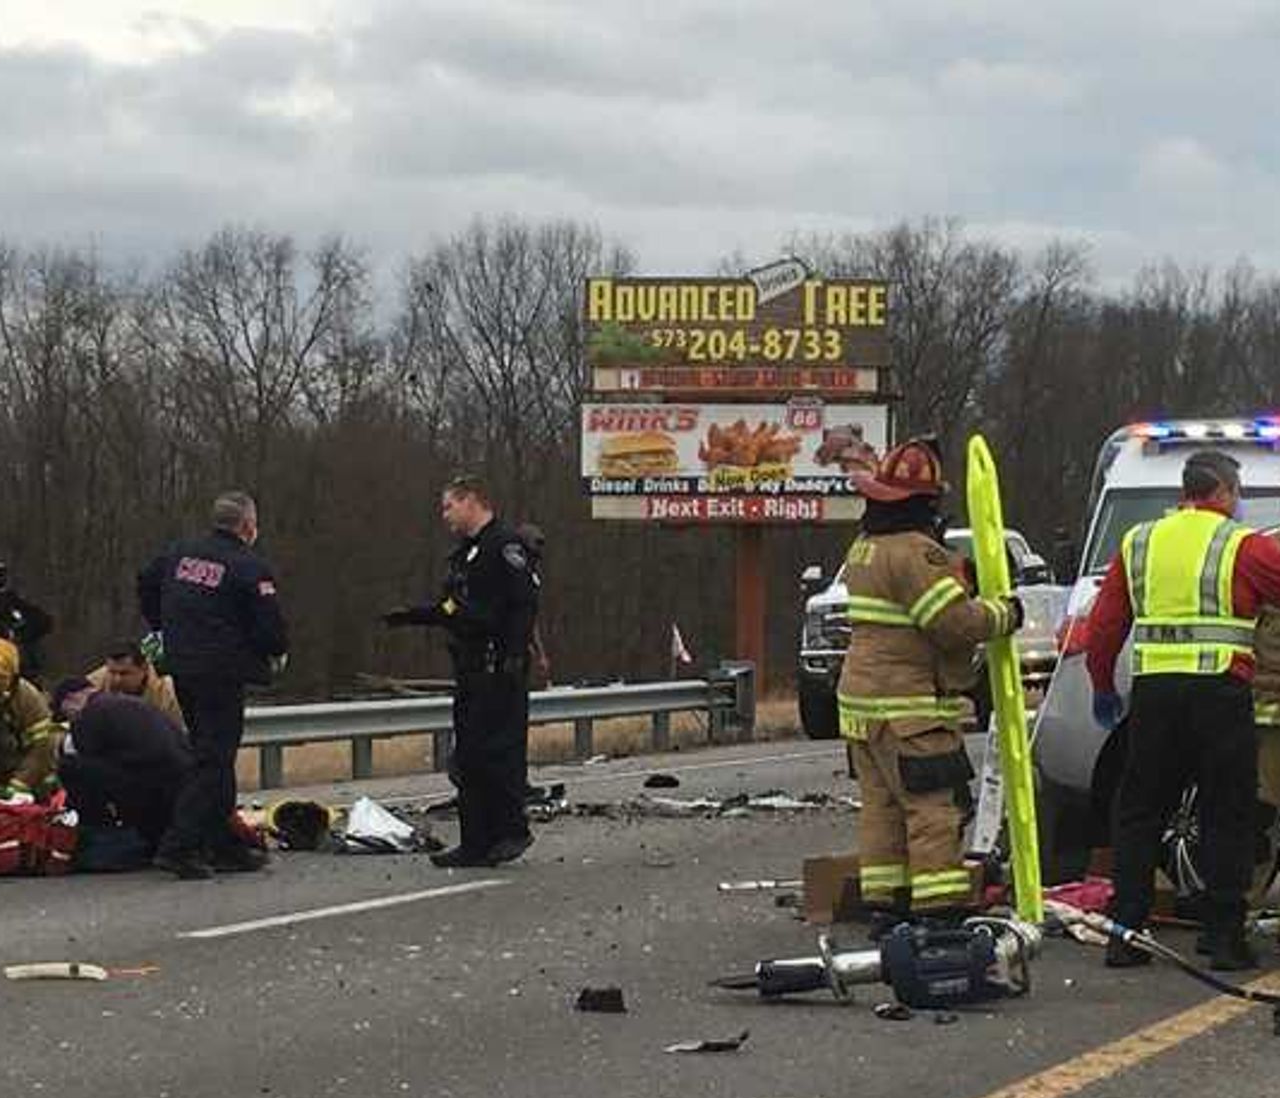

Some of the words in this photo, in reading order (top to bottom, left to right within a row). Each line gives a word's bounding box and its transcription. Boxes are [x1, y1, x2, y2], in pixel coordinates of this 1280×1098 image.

[589, 280, 756, 321] ADVANCED
[804, 280, 886, 325] TREE
[651, 329, 687, 347] 573
[688, 329, 841, 360] 204-8733
[591, 479, 636, 492] Diesel
[643, 479, 689, 492] Drinks
[651, 498, 700, 517] Next
[708, 498, 745, 517] Exit
[764, 497, 819, 519] Right
